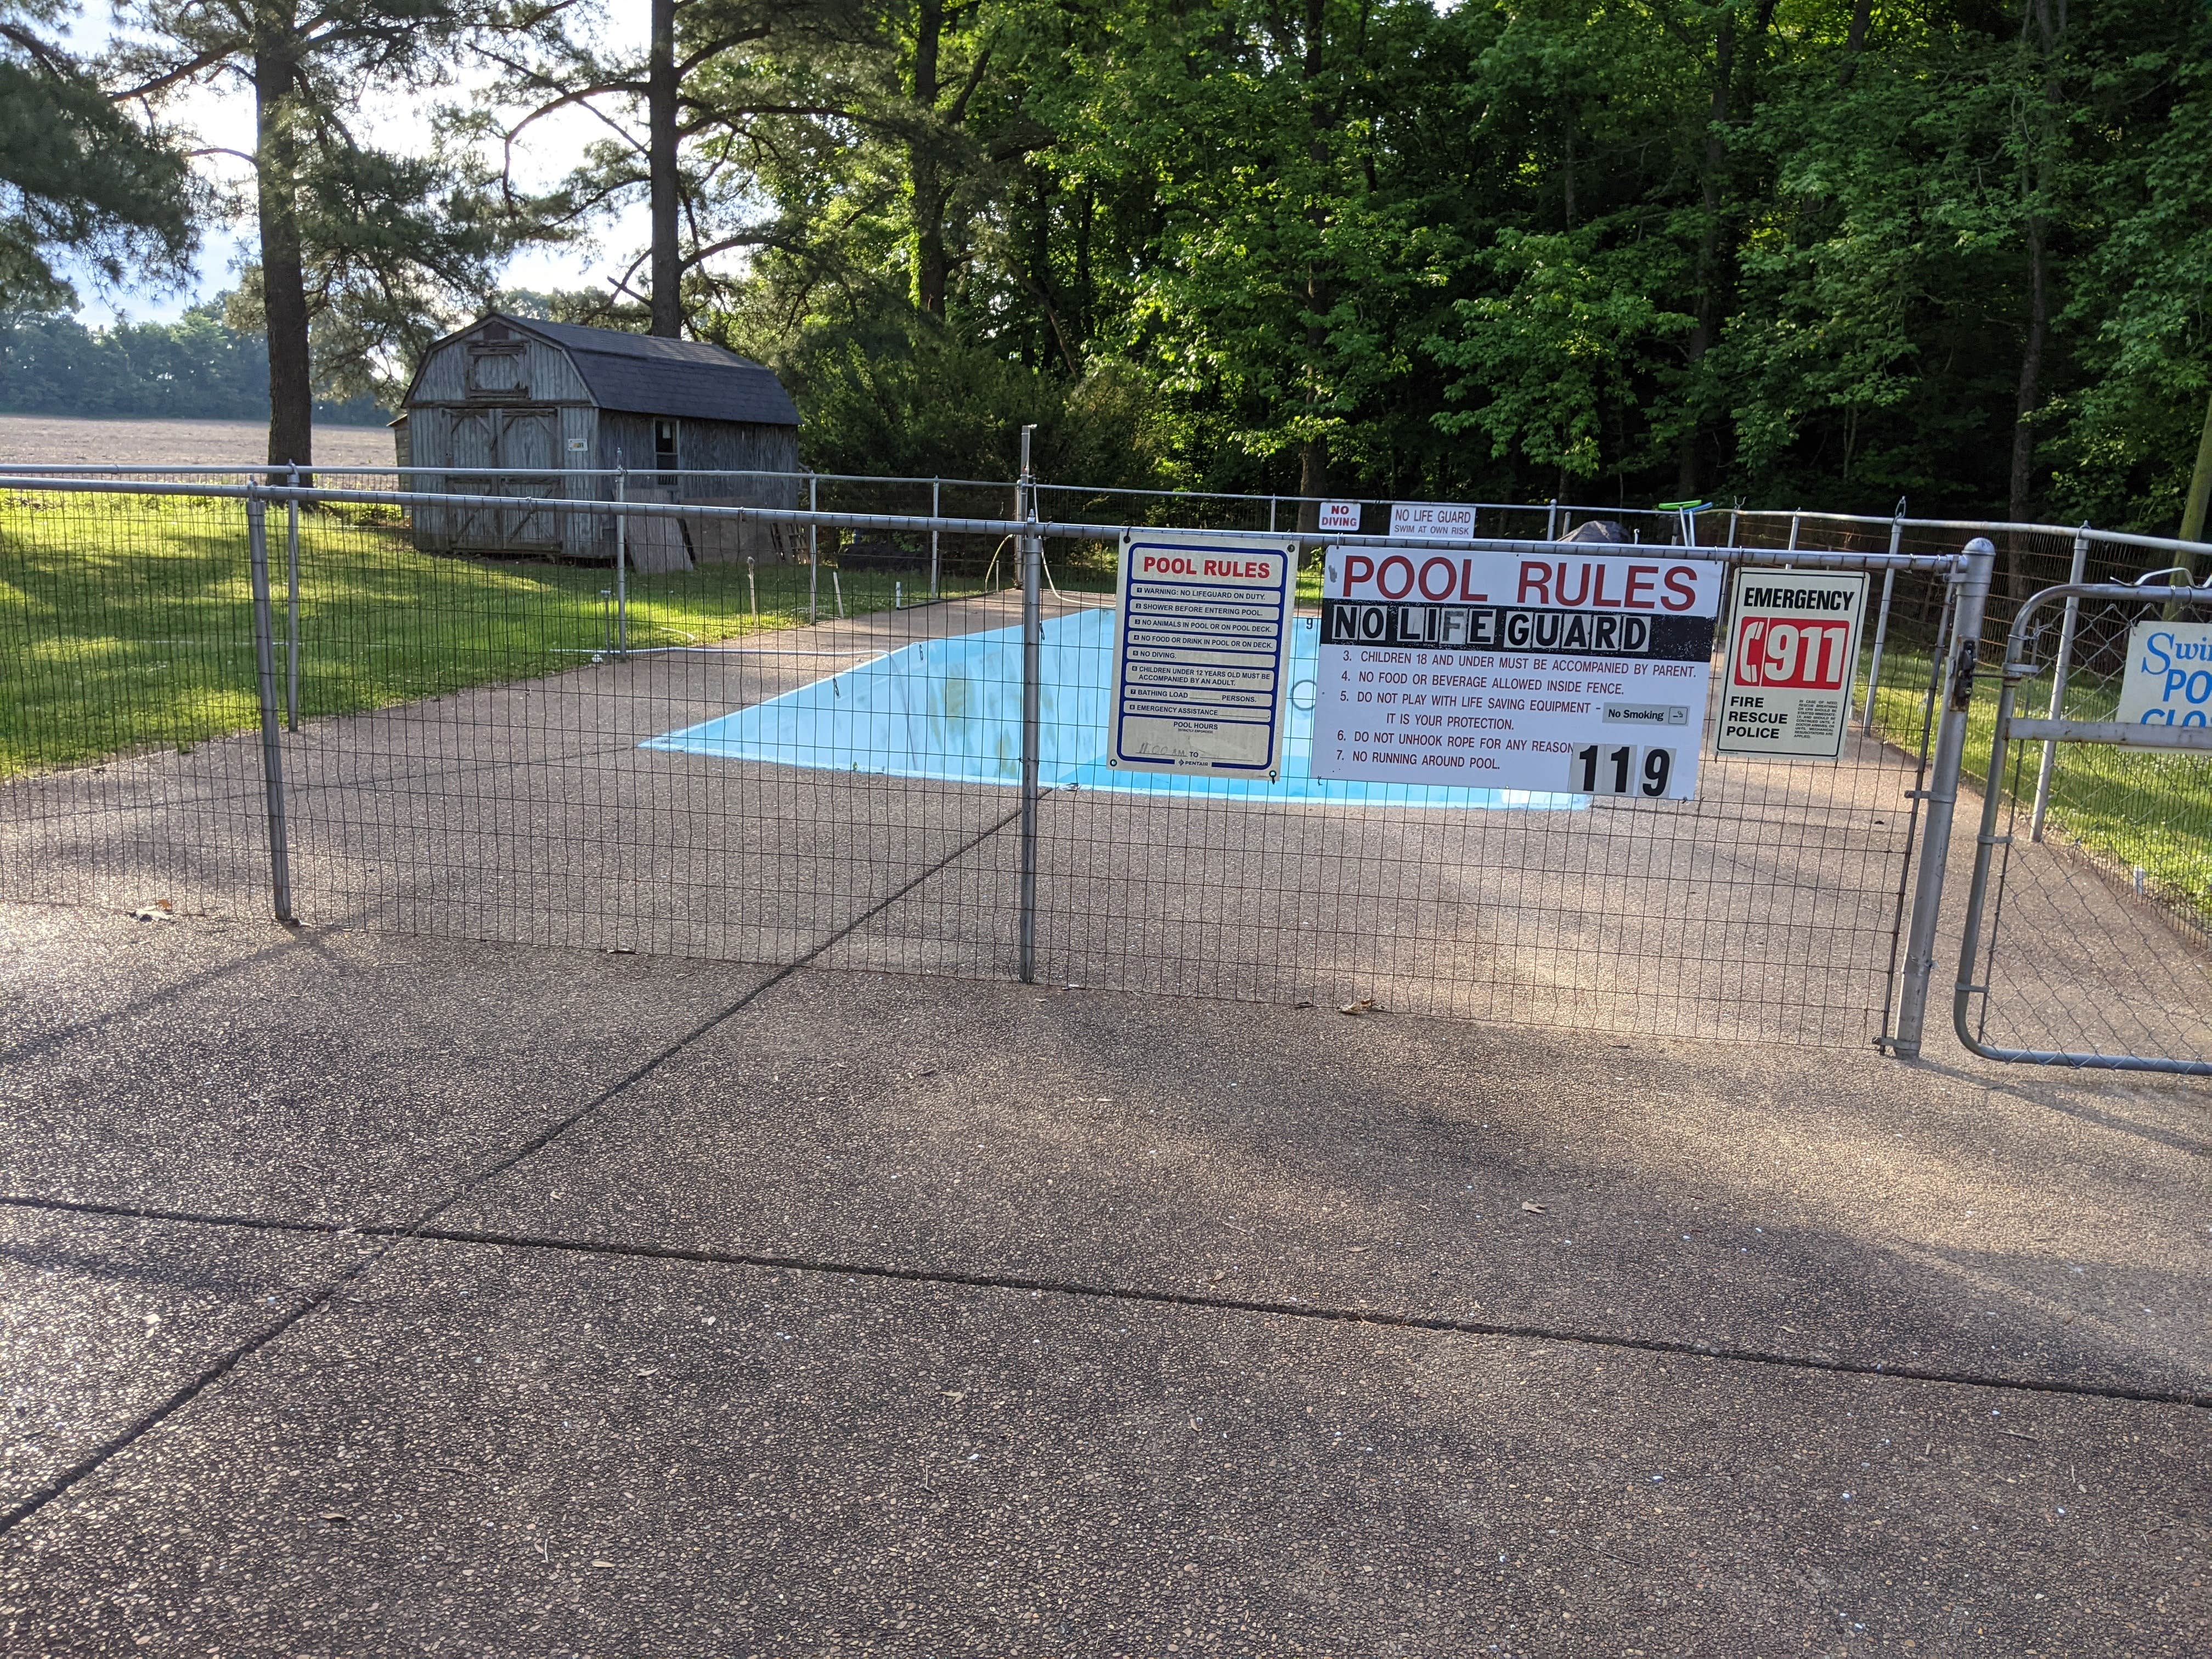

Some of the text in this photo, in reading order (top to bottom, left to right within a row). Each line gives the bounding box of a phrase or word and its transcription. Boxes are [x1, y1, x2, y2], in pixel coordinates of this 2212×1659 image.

[1331, 505, 1350, 515] NO
[1395, 509, 1471, 523] NO LIFE GUARD
[1322, 517, 1357, 527] DIVING
[1394, 524, 1414, 533] SWIM
[1452, 527, 1469, 535] RISK
[1144, 556, 1270, 579] POOL RULES
[1342, 555, 1698, 612] POOL RULES
[1743, 587, 1854, 611] EMERGENCY
[1306, 618, 1313, 629] 9
[1335, 606, 1647, 650] NO LIFE GUARD
[1764, 624, 1846, 682] 911
[2141, 633, 2212, 675] Swi
[1343, 651, 1696, 678] 3. CHILDREN 18 AND UNDER MUST BE ACCOMPANIED BY PARENT.
[1138, 674, 1188, 683] ACCOMPANIED
[1341, 671, 1624, 695] 4. NO FOOD OR BEVERAGE ALLOWED INSIDE FENCE.
[2163, 669, 2212, 704] PO
[1340, 691, 1349, 701] 5.
[1357, 691, 1372, 702] DO
[1377, 693, 1398, 703] NOT
[1402, 694, 1427, 705] PLAY
[1431, 696, 1457, 707] WITH
[1462, 697, 1482, 708] LIFE
[1488, 698, 1525, 710] SAVING
[1530, 700, 1591, 713] EQUIPMENT
[1730, 696, 1764, 708] FIRE
[1386, 713, 1514, 730] IT IS YOUR PROTECTION.
[1608, 709, 1664, 721] No Smoking
[1728, 711, 1788, 724] RESCUE
[1338, 730, 1346, 741] 6.
[1354, 731, 1369, 742] DO
[1374, 732, 1395, 743] NOT
[1398, 733, 1442, 747] UNHOOK
[1447, 736, 1475, 748] ROPE
[1480, 738, 1501, 749] FOR
[1505, 740, 1527, 751] ANY
[1726, 726, 1780, 739] POLICE
[1336, 750, 1500, 769] 7. NO RUNNING AROUND POOL.
[1579, 745, 1670, 797] 119
